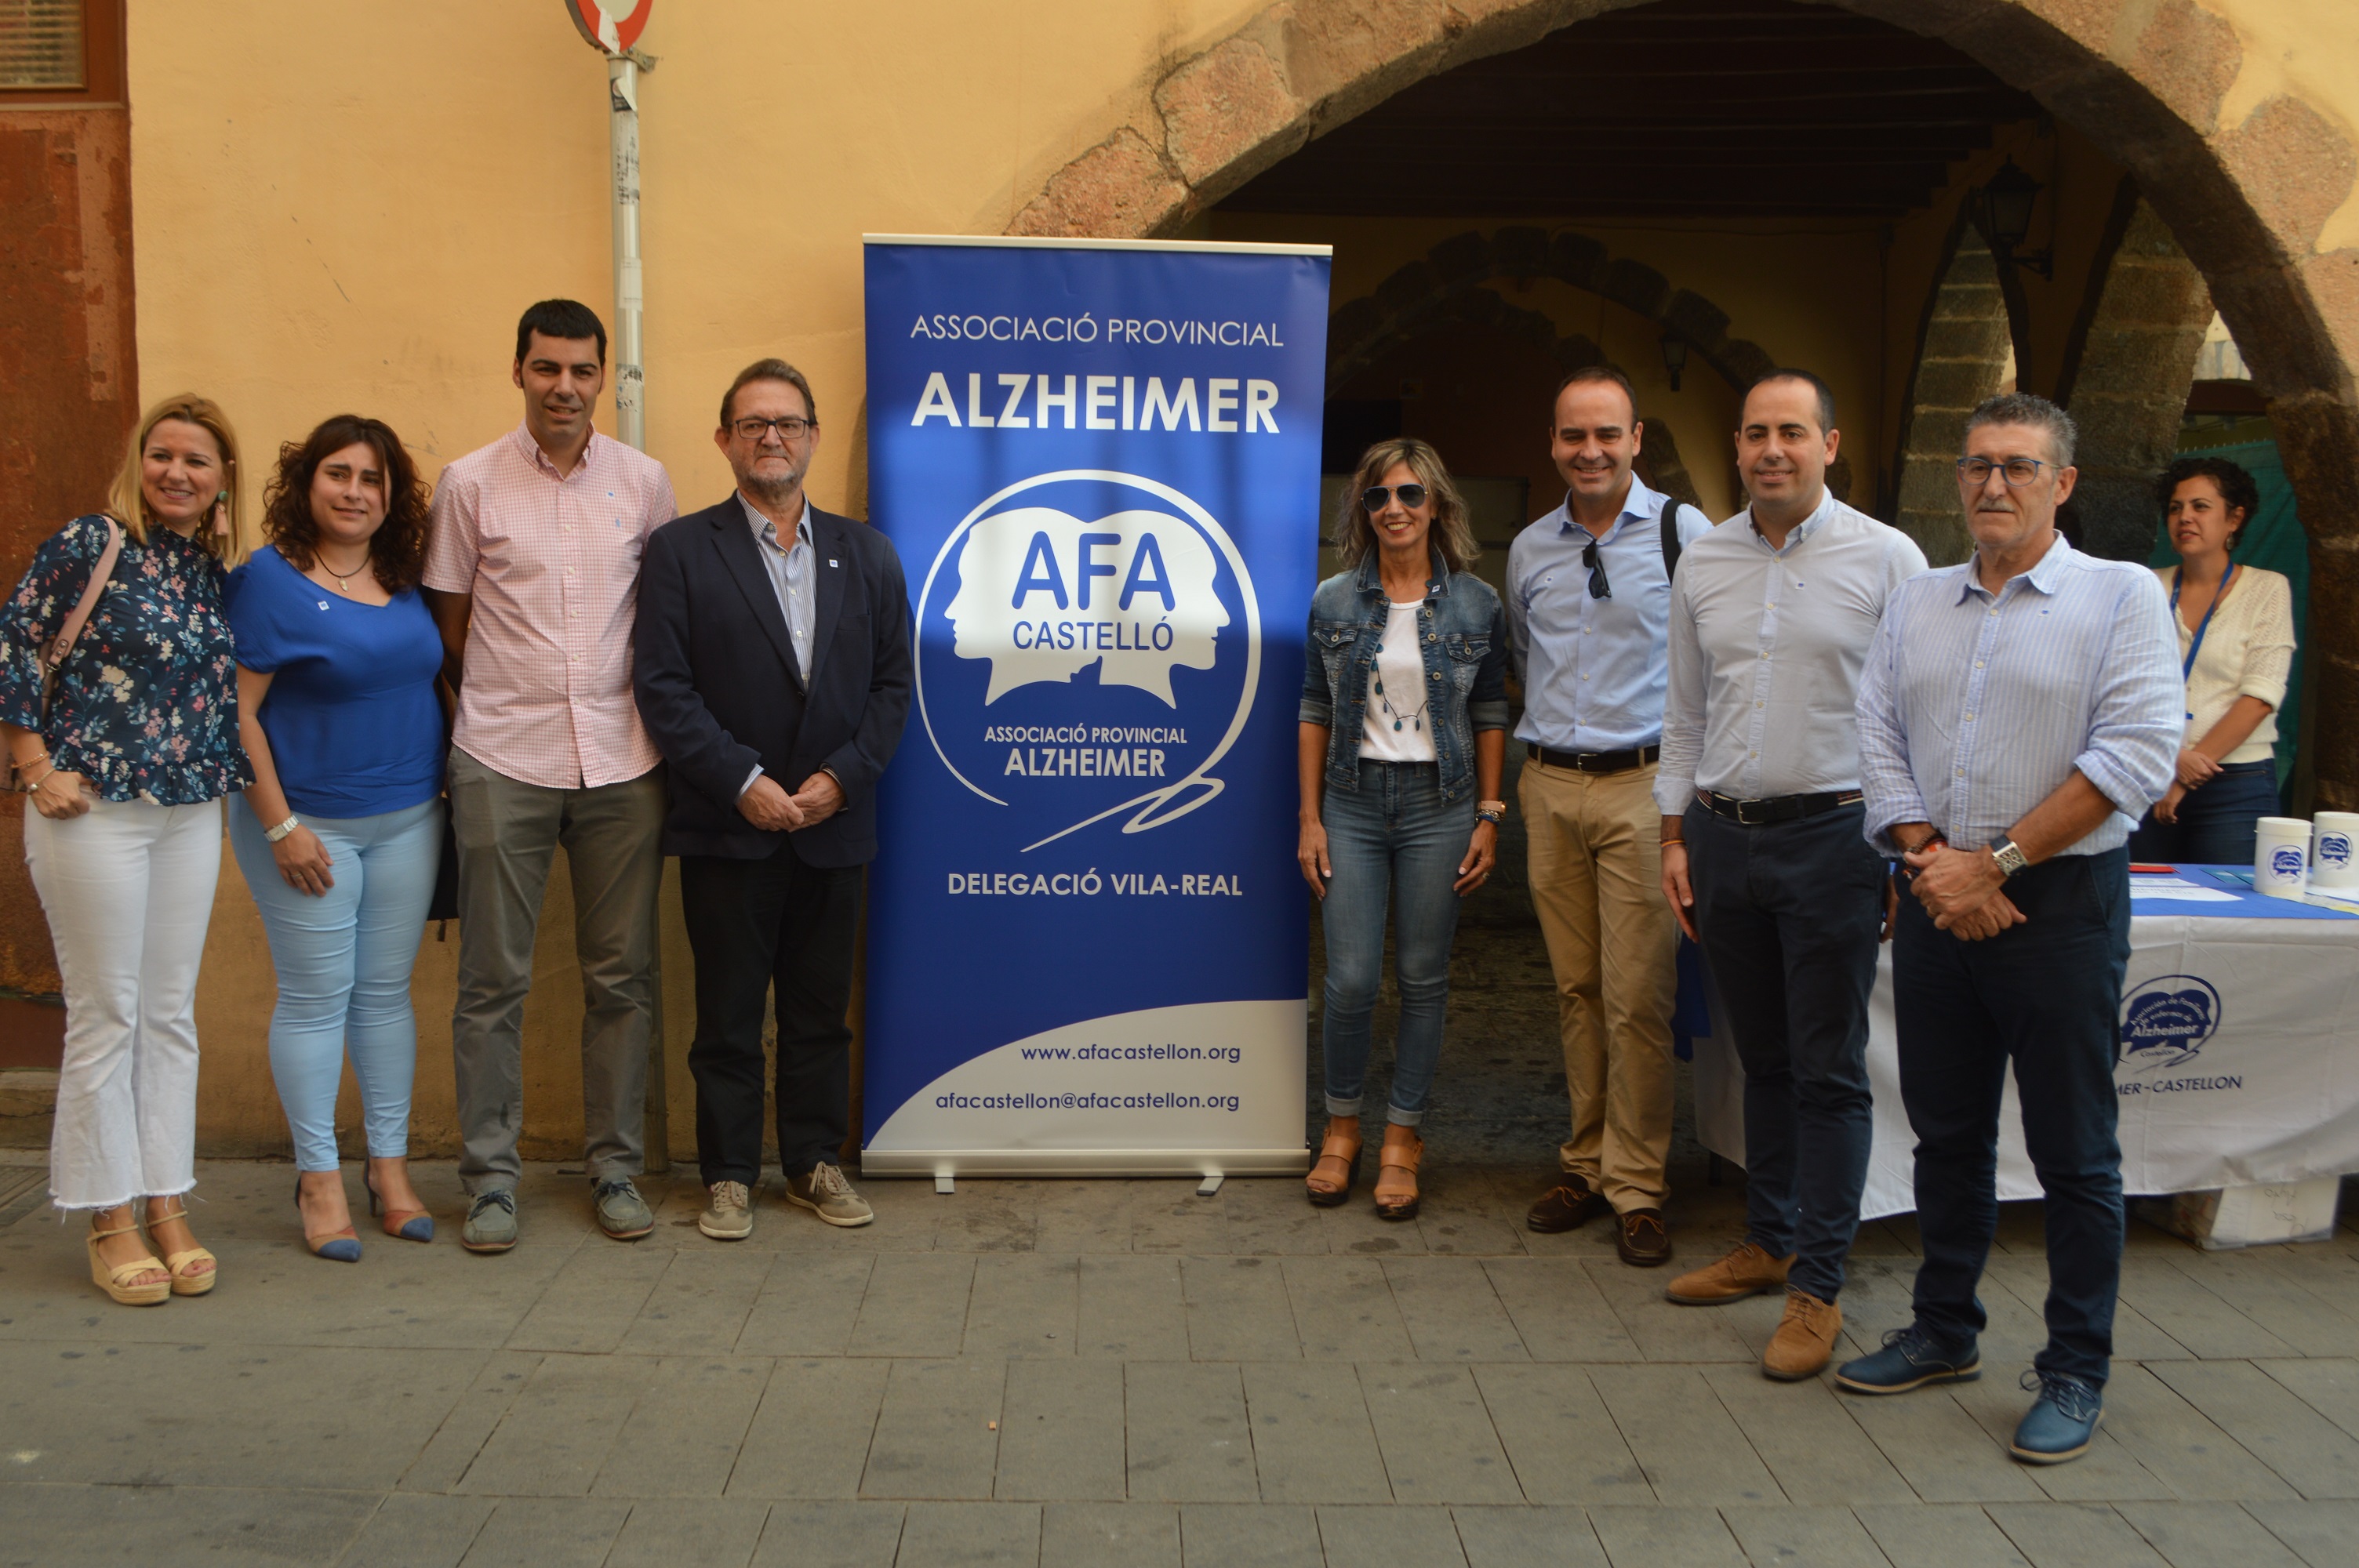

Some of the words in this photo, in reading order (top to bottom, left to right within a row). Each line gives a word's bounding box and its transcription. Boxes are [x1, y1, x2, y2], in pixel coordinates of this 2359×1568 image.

[910, 312, 1098, 343] ASSOCIACIÓ
[1107, 318, 1285, 347] PROVINCIAL
[911, 372, 1281, 434] ALZHEIMER
[1012, 531, 1176, 612] AFA
[1012, 616, 1174, 652] CASTELLÓ
[984, 722, 1087, 744] ASSOCIACIÓ
[1091, 727, 1187, 744] PROVINCIAL
[1004, 748, 1165, 777] ALZHEIMER
[947, 867, 1103, 895] DELEGACIÓ
[1110, 873, 1243, 896] VILA-REAL
[2130, 1023, 2200, 1037] Alzheimer
[1020, 1044, 1241, 1064] www.afacastellon.org
[935, 1092, 1240, 1112] afacastellon@afacastellon.org
